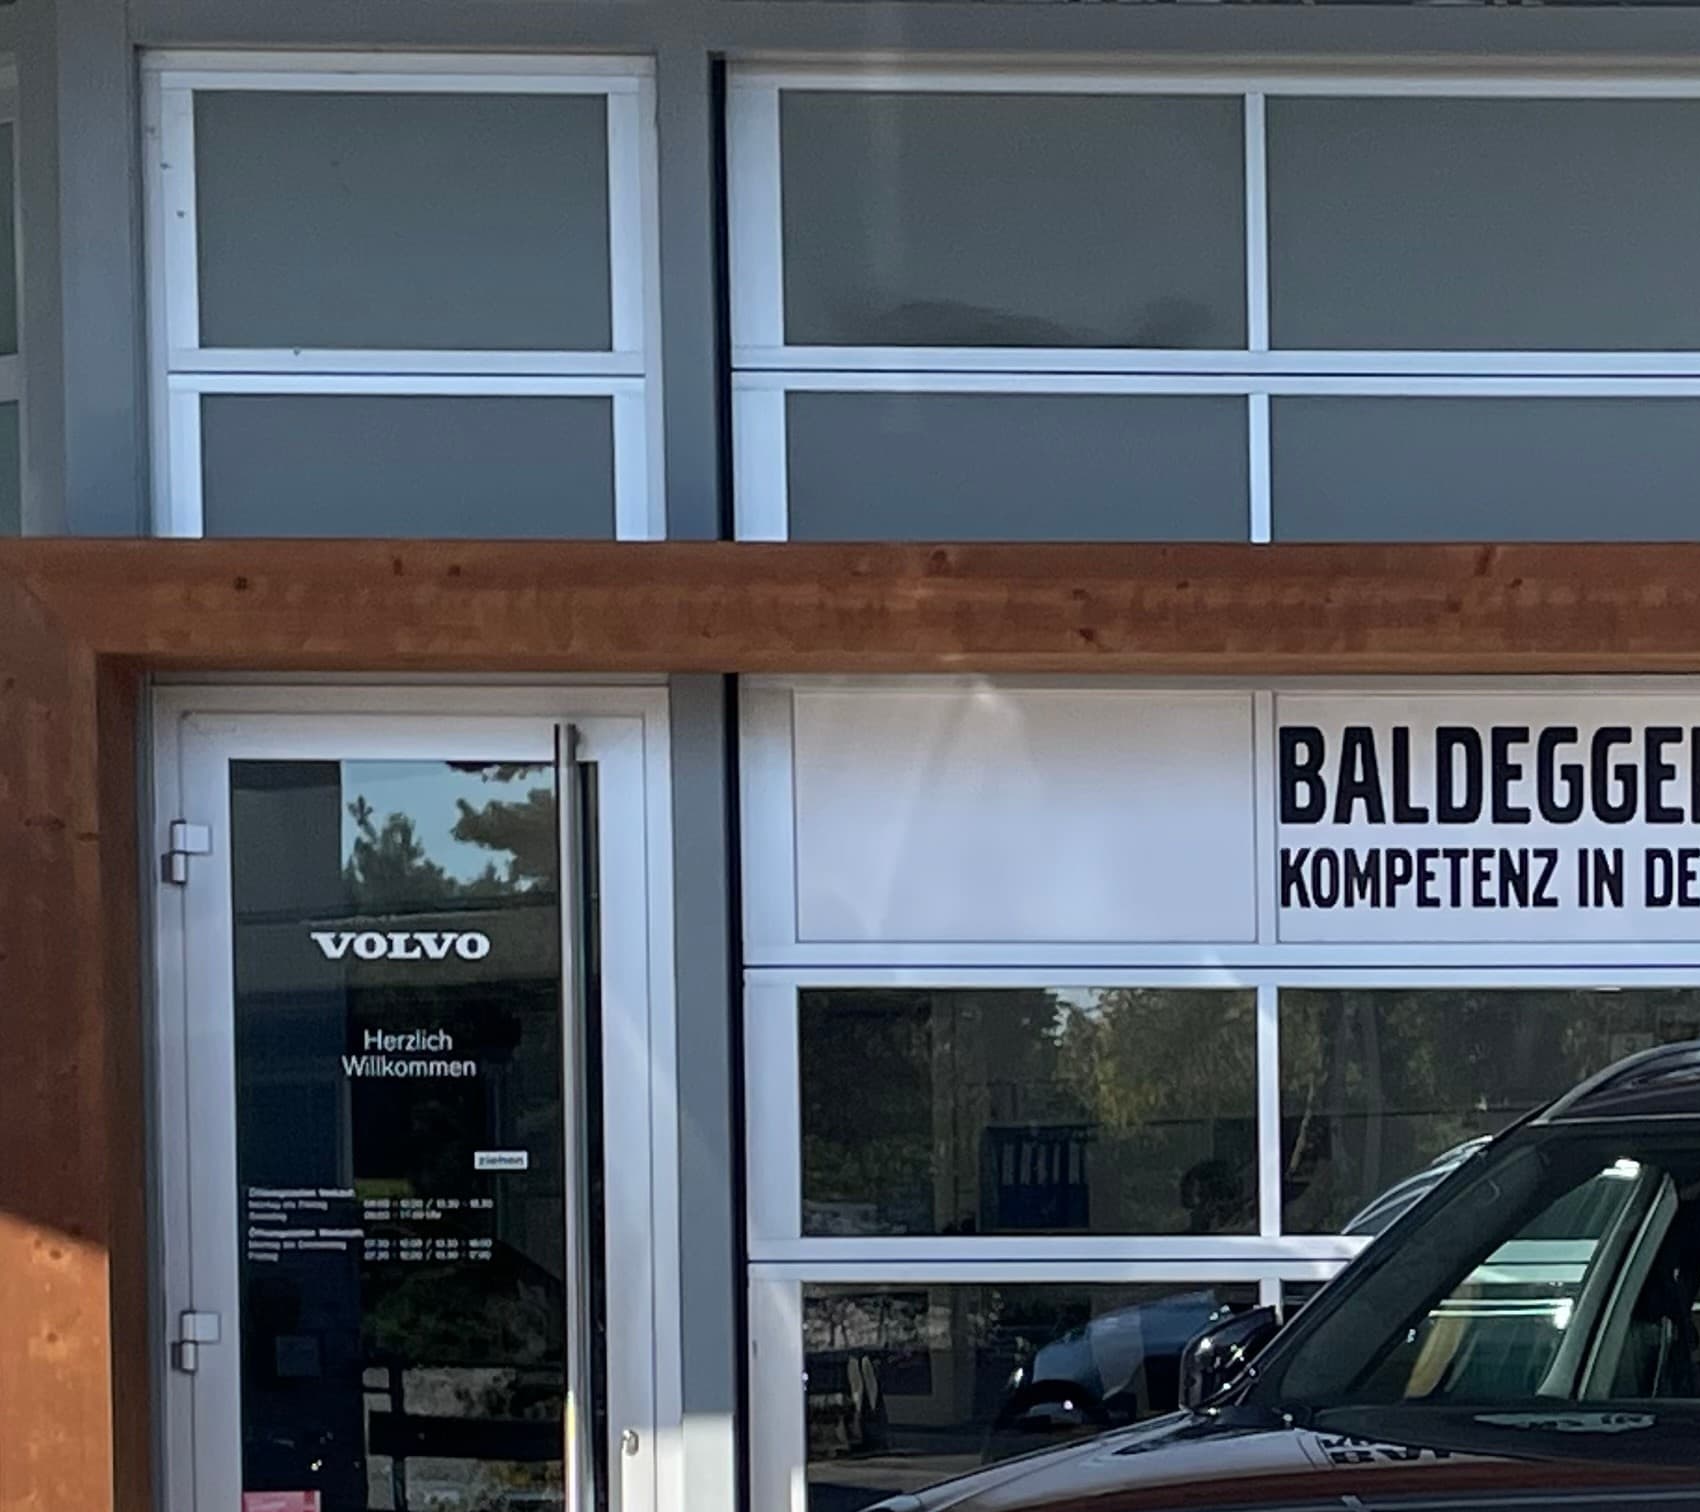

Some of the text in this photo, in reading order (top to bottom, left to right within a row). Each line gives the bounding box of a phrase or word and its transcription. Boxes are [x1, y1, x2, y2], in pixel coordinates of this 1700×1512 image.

[1279, 846, 1560, 909] KOMPETENZ
[1578, 846, 1624, 909] IN
[310, 931, 491, 960] VOLVO
[363, 1028, 453, 1052] Herzlich
[341, 1055, 477, 1078] Willkommen
